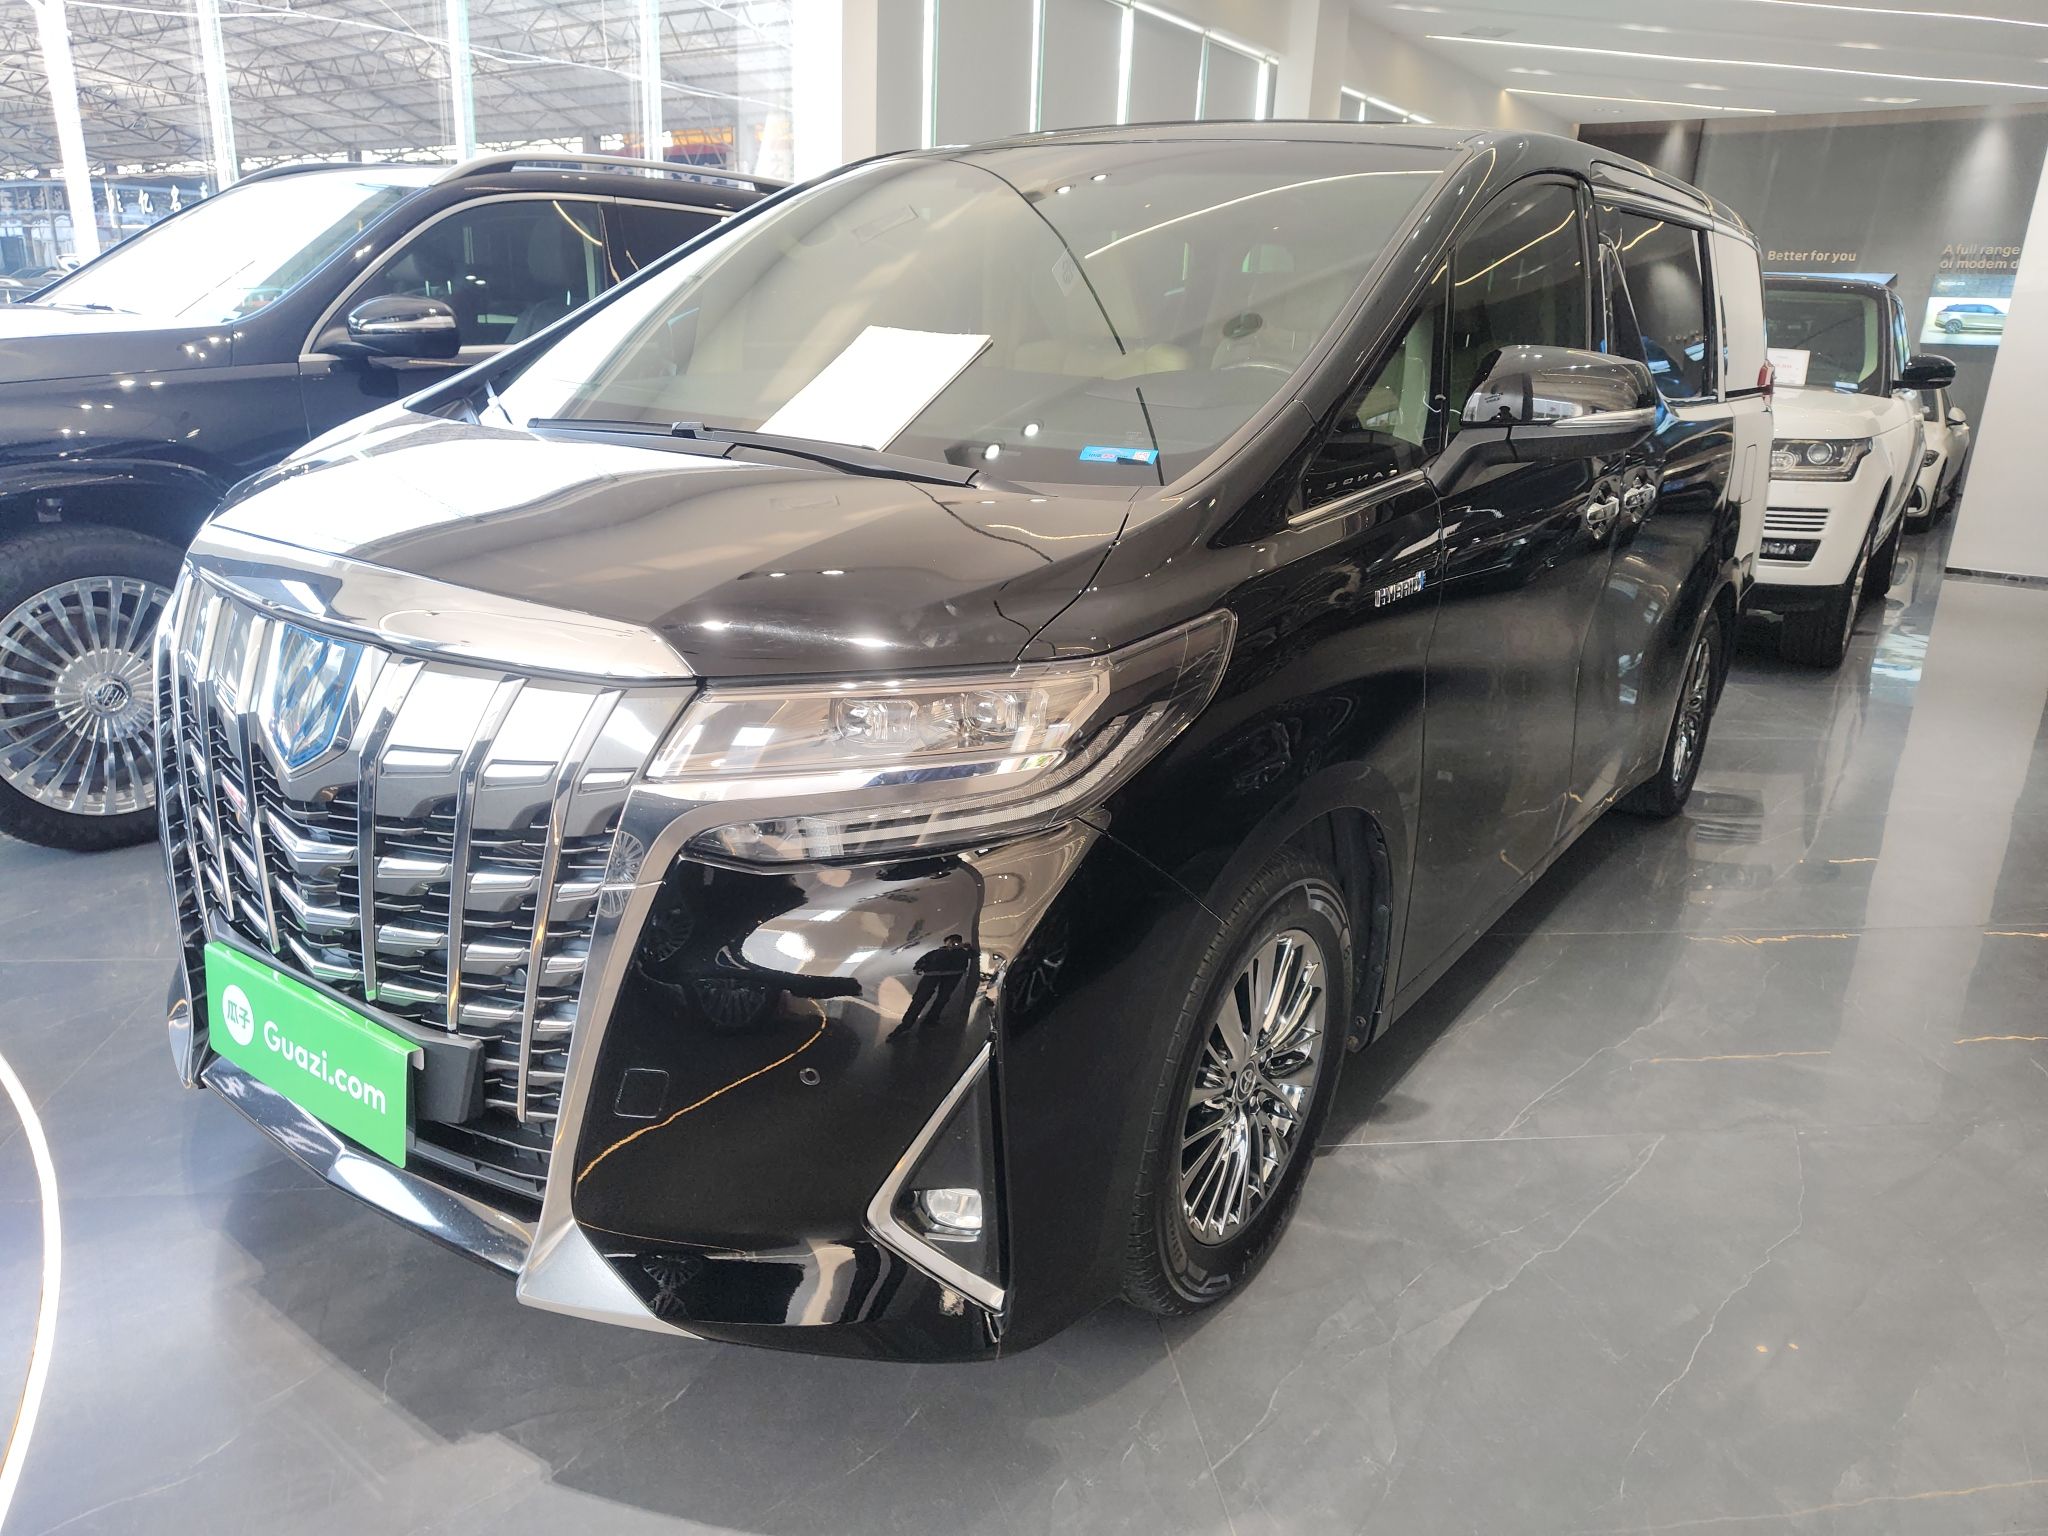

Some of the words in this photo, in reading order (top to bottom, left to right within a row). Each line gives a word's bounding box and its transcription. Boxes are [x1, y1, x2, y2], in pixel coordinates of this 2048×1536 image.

[1767, 250, 1808, 261] Better
[1810, 250, 1830, 261] for
[1831, 252, 1857, 264] you
[1943, 244, 1953, 255] A
[1956, 244, 1977, 255] full
[1980, 246, 2020, 257] range
[227, 999, 251, 1030] 瓜子
[263, 1020, 386, 1115] Guazi.com
